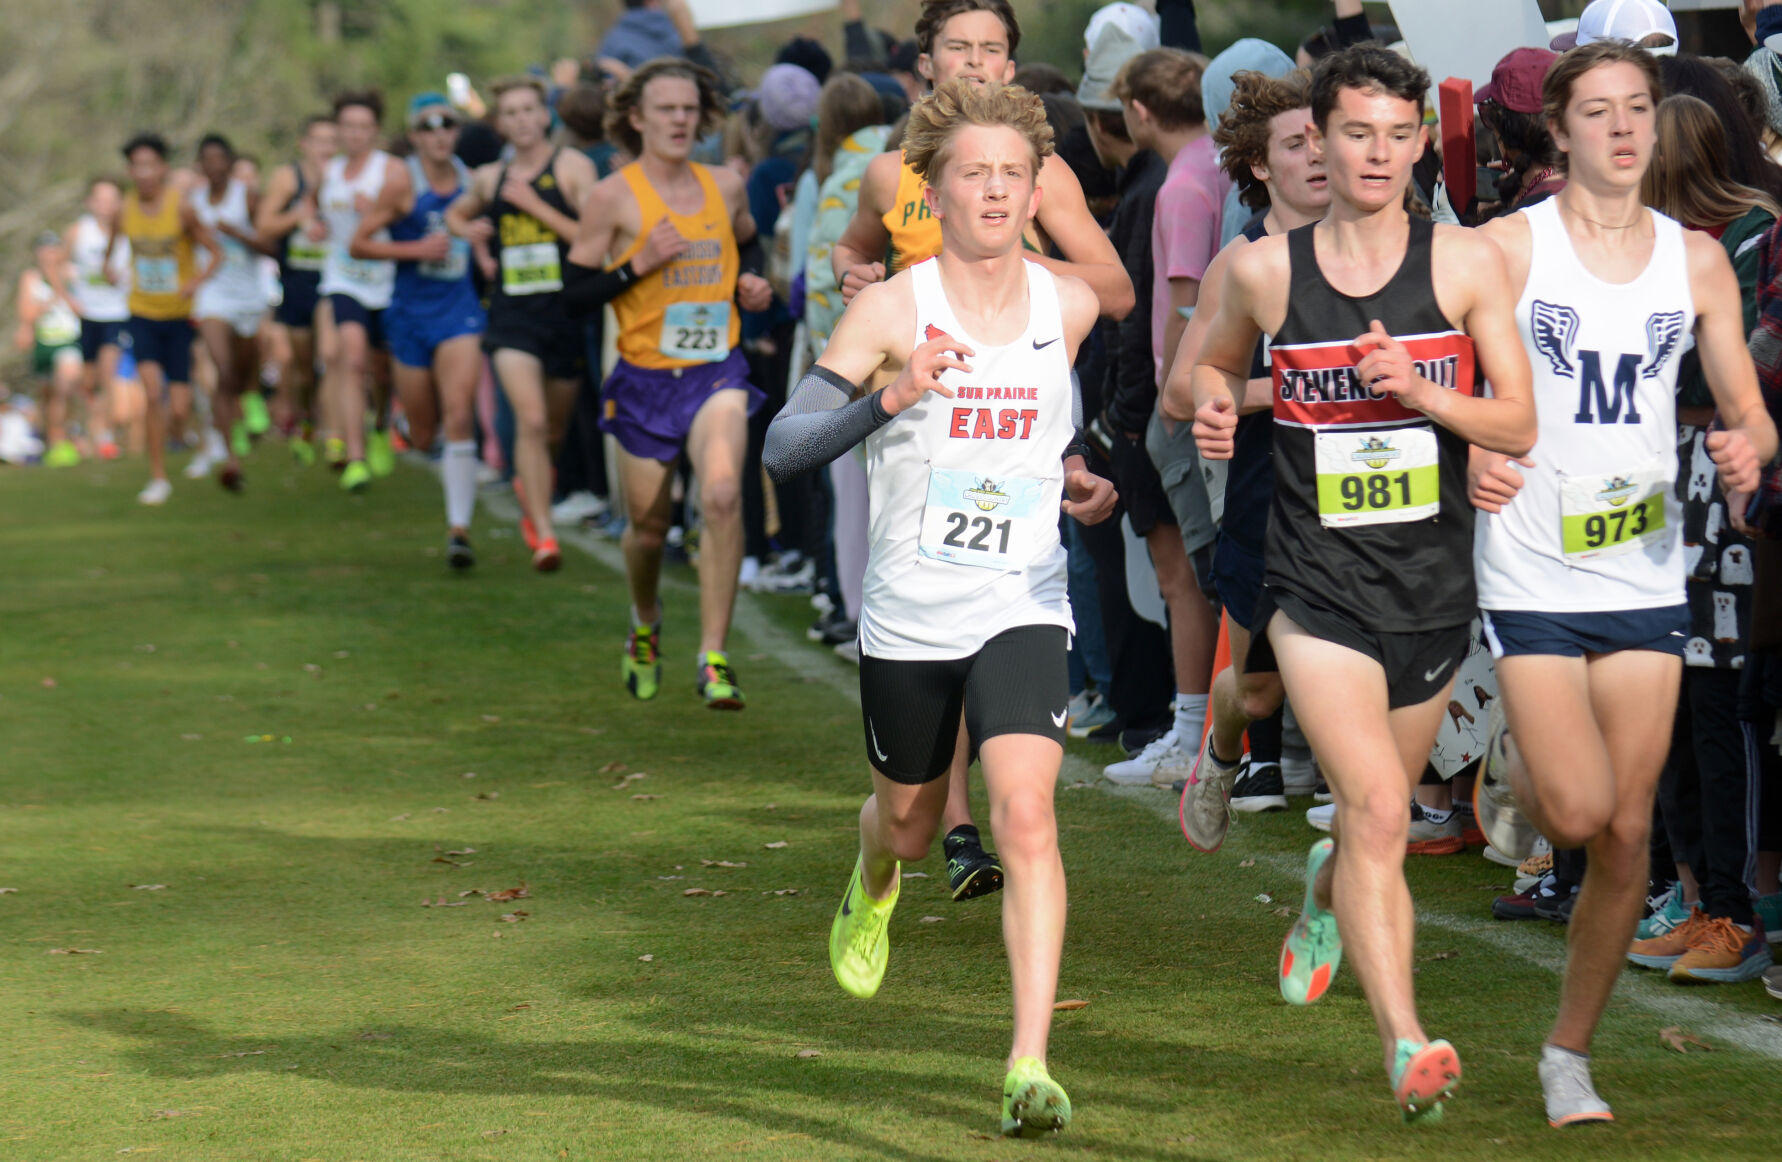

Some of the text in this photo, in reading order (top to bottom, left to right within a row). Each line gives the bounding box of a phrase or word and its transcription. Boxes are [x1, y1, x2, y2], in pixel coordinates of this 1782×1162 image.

[676, 328, 718, 349] 223
[957, 386, 1038, 400] SUN PRAIRIE
[1574, 349, 1644, 425] M
[949, 407, 1039, 440] EAST
[1340, 472, 1412, 510] 981
[943, 512, 1012, 554] 221
[1585, 502, 1649, 548] 973
